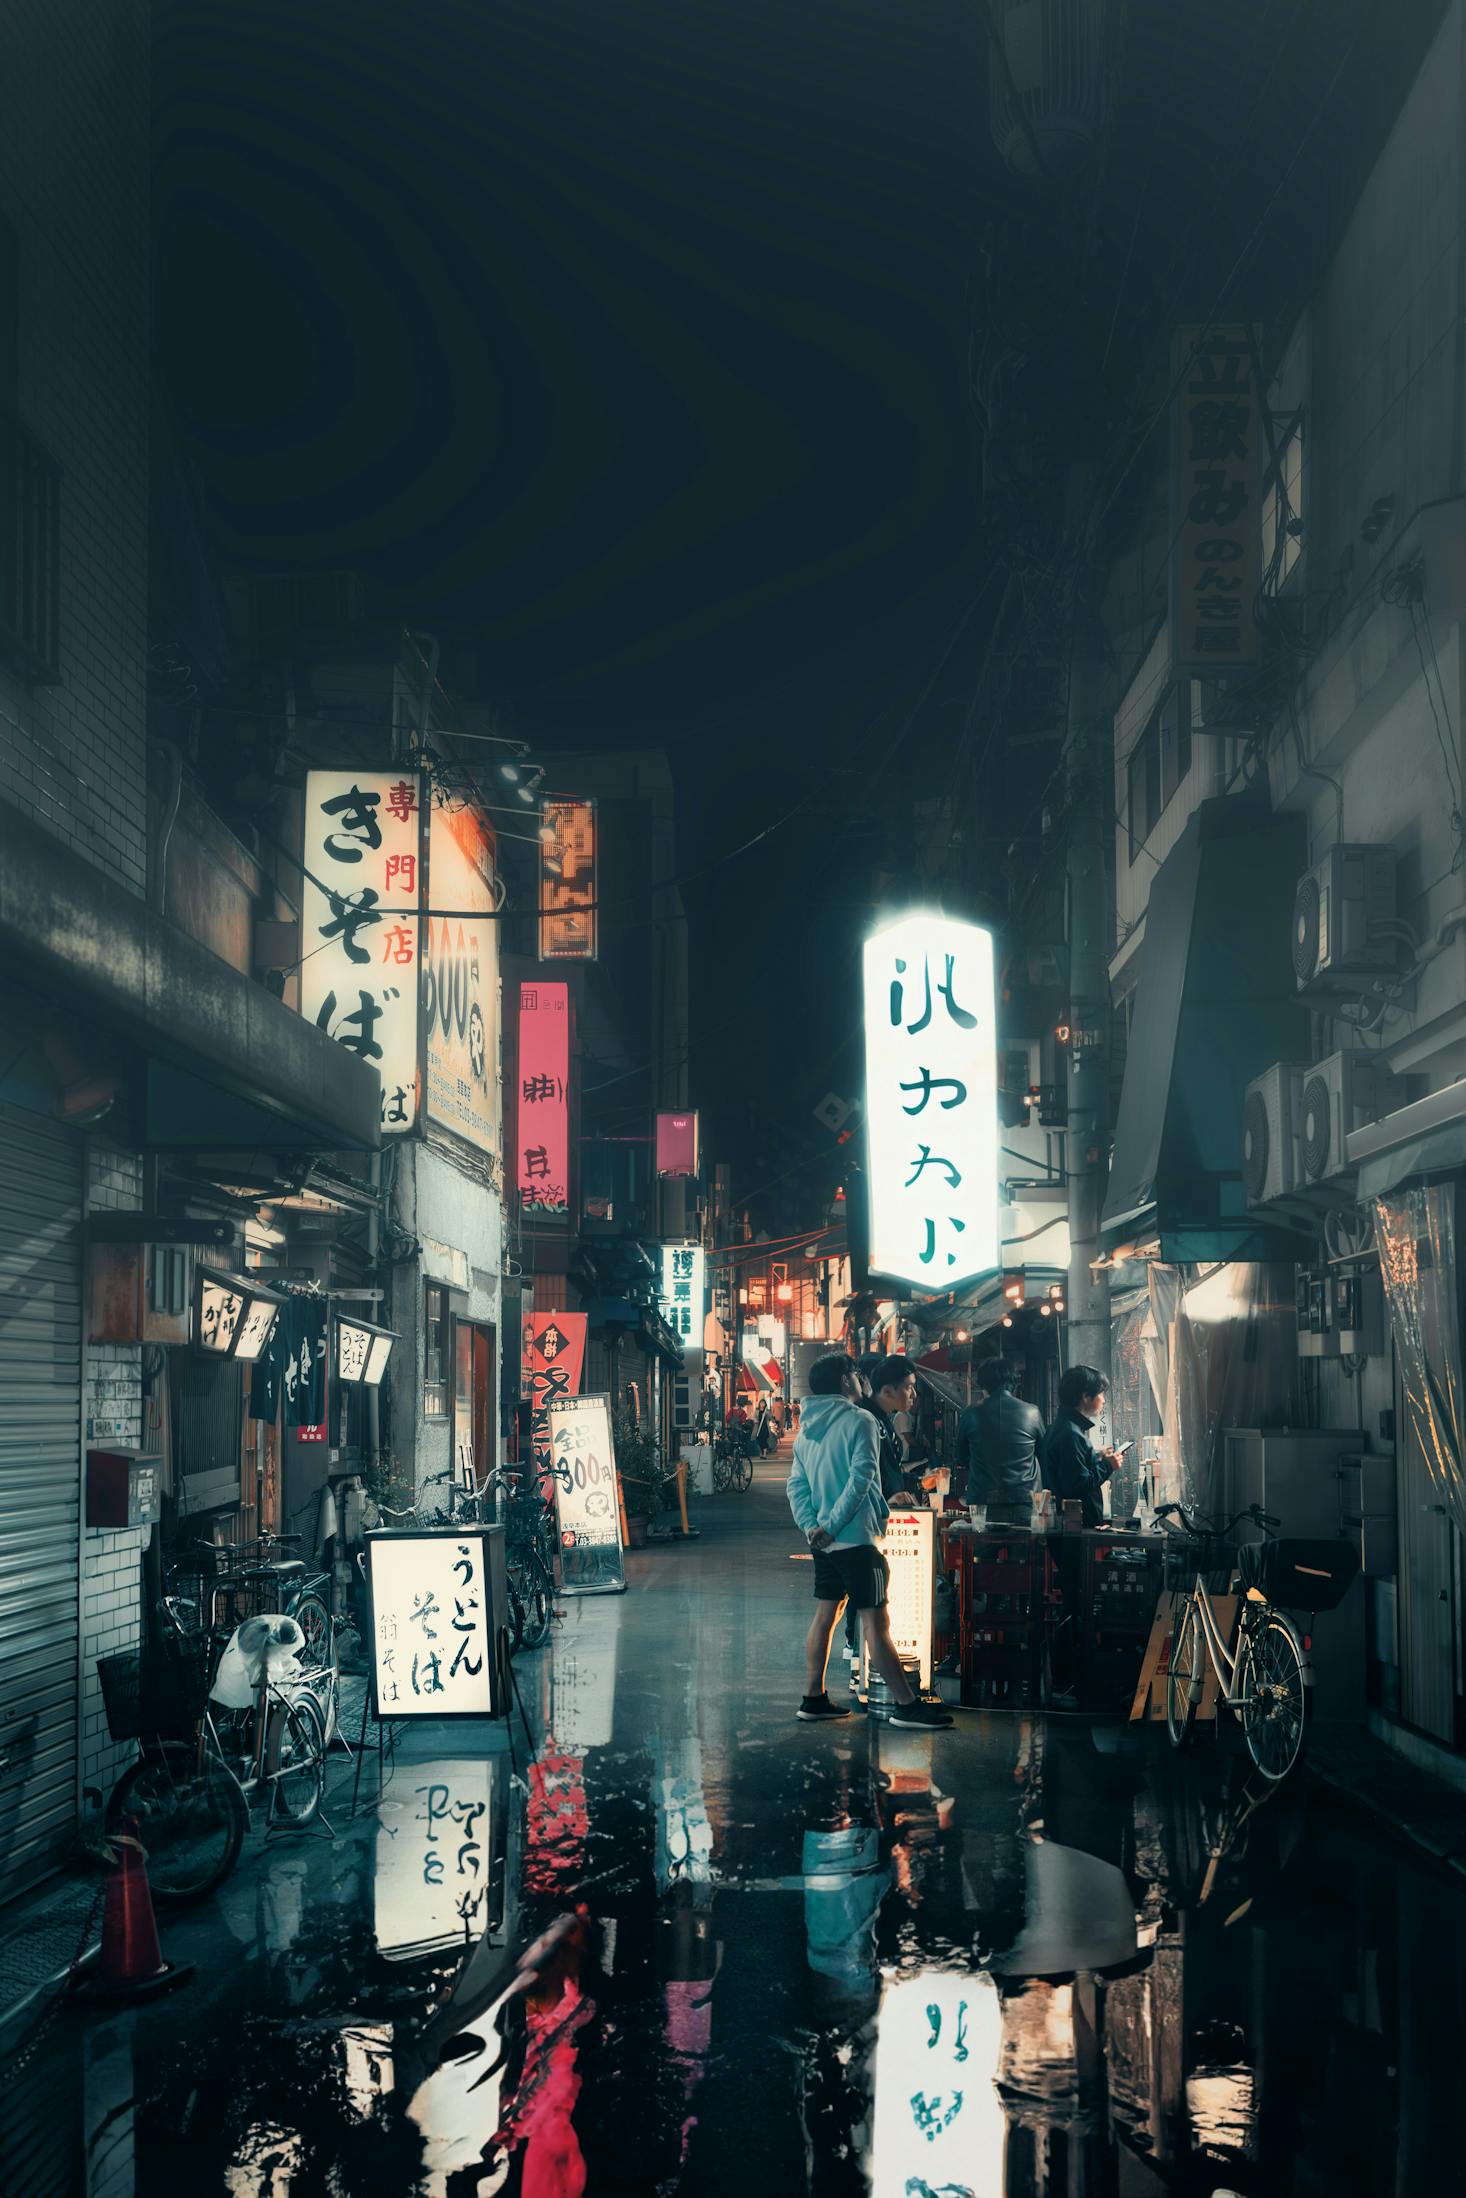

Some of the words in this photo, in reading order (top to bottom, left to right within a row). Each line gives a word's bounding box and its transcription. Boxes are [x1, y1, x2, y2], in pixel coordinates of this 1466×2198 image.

[316, 784, 400, 1060] きそば
[383, 780, 419, 965] 専門店
[380, 1613, 402, 1702] 翁そば
[409, 1591, 445, 1695] そば
[449, 1545, 482, 1677] うどん
